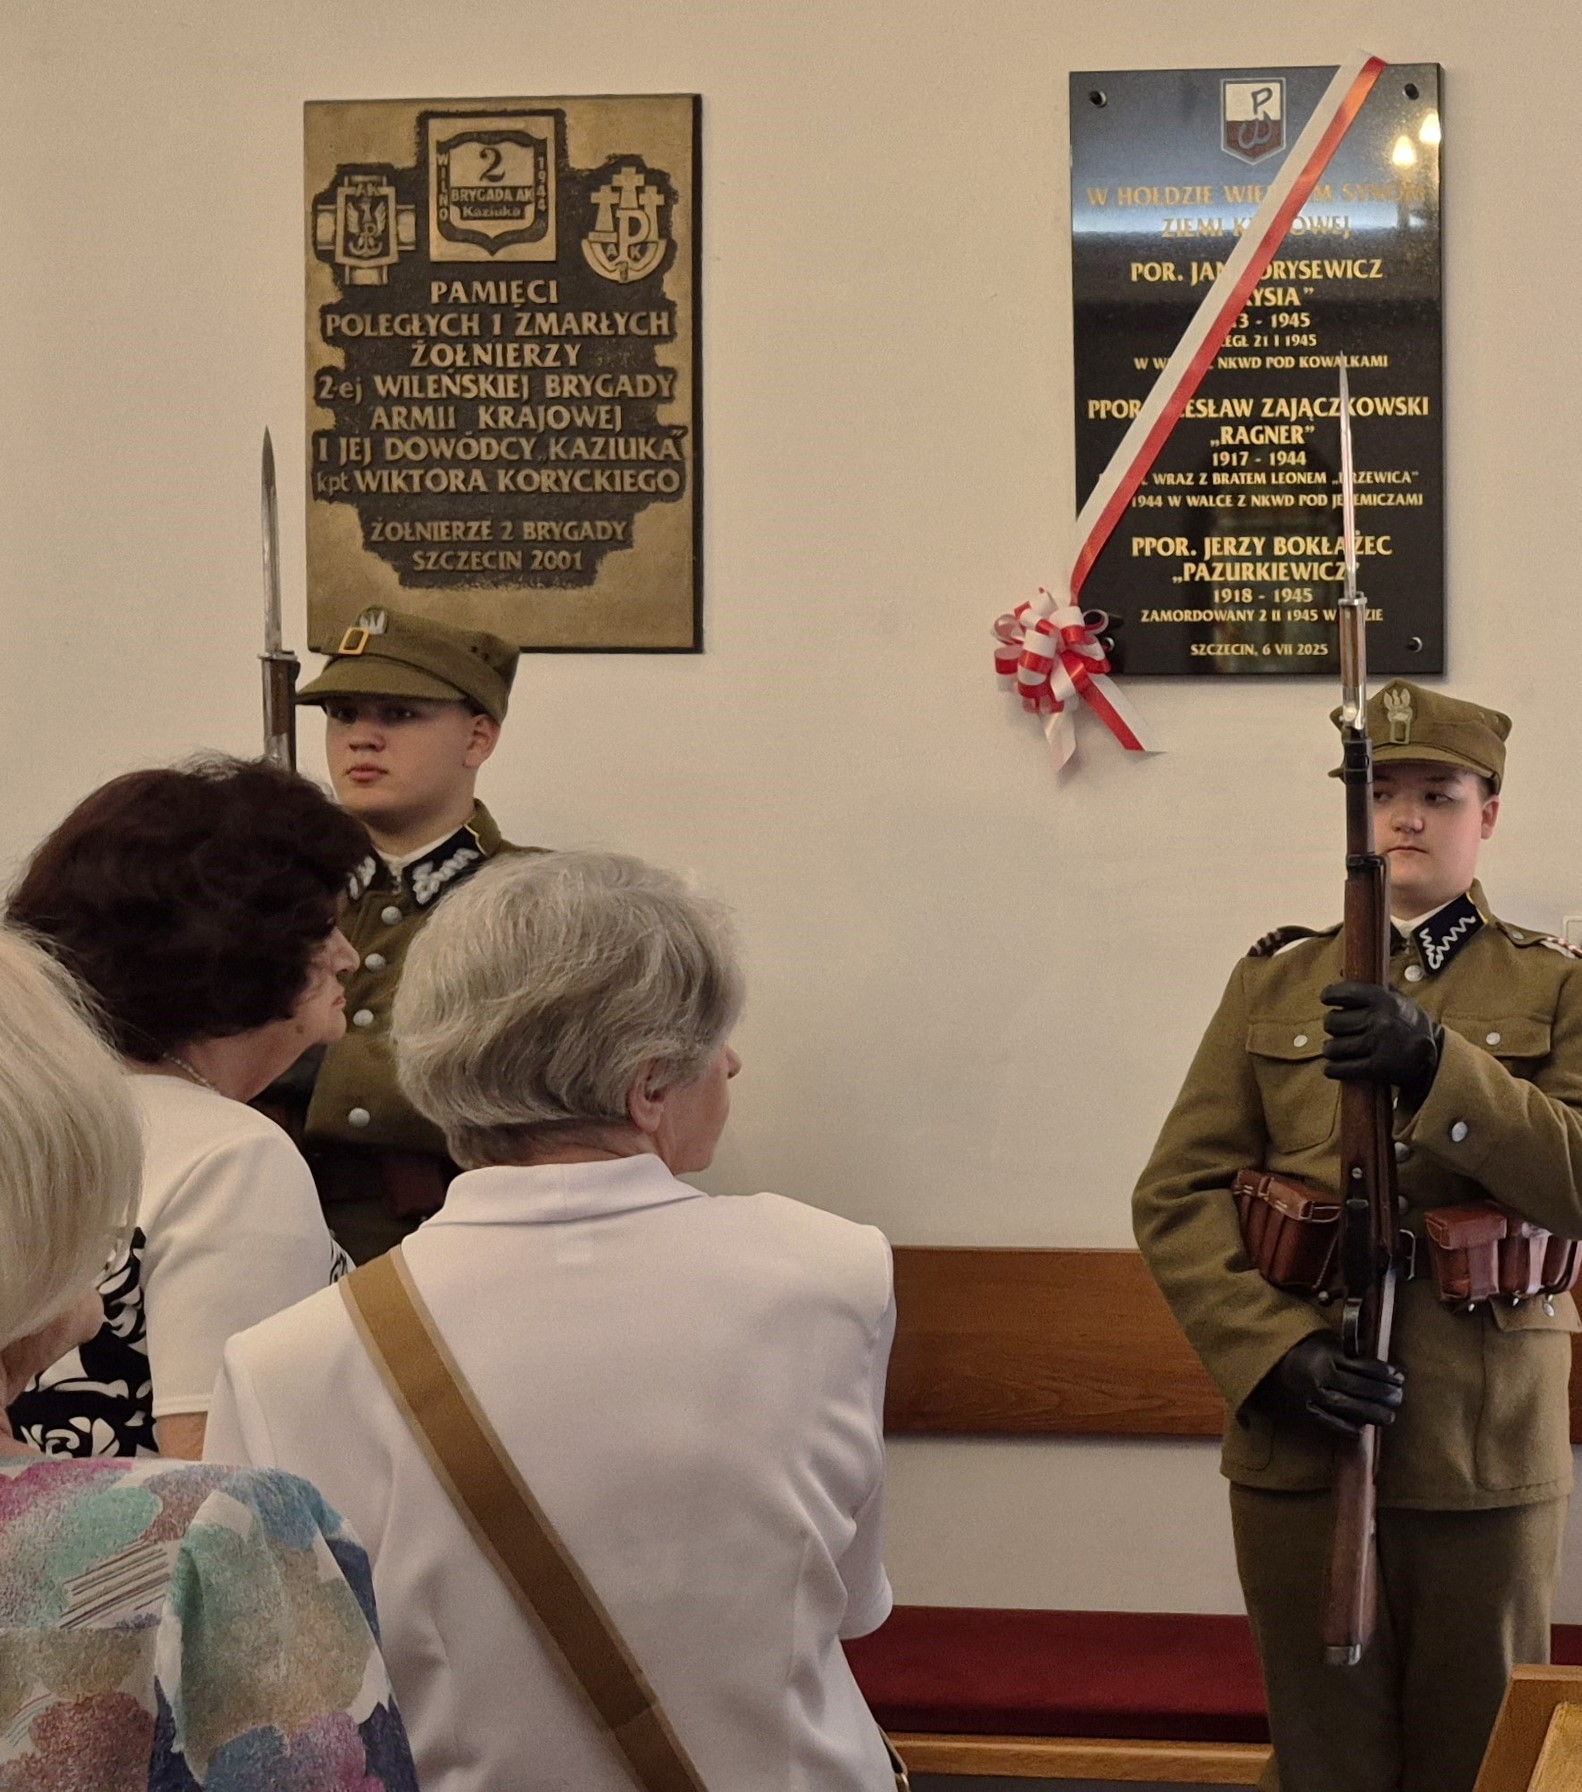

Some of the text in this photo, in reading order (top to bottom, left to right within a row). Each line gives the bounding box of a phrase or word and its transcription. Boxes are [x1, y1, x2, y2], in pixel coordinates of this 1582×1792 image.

[479, 147, 506, 183] 2
[451, 188, 535, 202] BRYGADA AK
[1087, 187, 1109, 206] W
[1161, 217, 1224, 238] ZIEMI
[1130, 261, 1184, 283] POR.
[1190, 260, 1228, 286] JA
[430, 280, 559, 307] PAMIĘCI
[326, 311, 671, 338] POLEGŁYCH I ZMARŁYCH
[1270, 311, 1312, 330] 1945
[1253, 334, 1269, 348] 21
[1285, 333, 1318, 347] 1945
[410, 341, 582, 368] ŻOŁNIERZY
[1133, 357, 1149, 370] W
[1217, 356, 1263, 370] NKWD
[1265, 355, 1296, 369] POD
[373, 368, 529, 404] WILEŃSKIEJ
[545, 373, 676, 399] BRYGADY
[369, 404, 622, 435] ARMII KRAJOWEJ
[1209, 425, 1316, 448] „RAGNER”
[319, 437, 328, 462] I
[339, 437, 372, 467] JEJ
[384, 431, 535, 462] DOWÓDCY
[1211, 451, 1250, 467] 1917
[1268, 450, 1308, 466] 1944
[353, 468, 488, 493] WIKTORA
[499, 468, 681, 493] KORYCKIEGO
[1152, 472, 1195, 486] WRAZ
[1199, 472, 1208, 485] Z
[1211, 471, 1266, 486] BRATEM
[1271, 471, 1327, 485] LEONEM
[1131, 495, 1163, 508] 1944
[1167, 494, 1182, 508] W
[1186, 494, 1234, 508] WALCE
[1236, 494, 1246, 507] Z
[1250, 494, 1295, 507] NKWD
[1298, 493, 1329, 507] POD
[370, 517, 627, 542] ŻOŁNIERZE 2 BRYGADY
[1131, 536, 1197, 557] PPOR.
[1203, 536, 1266, 559] JERZY
[413, 549, 582, 571] SZCZECIN 2001
[1213, 587, 1253, 604] 1918
[1273, 587, 1313, 604] 1945
[1140, 609, 1255, 623] ZAMORDOWANY
[1258, 609, 1268, 622] 2
[1286, 608, 1319, 622] 1945
[1322, 608, 1338, 622] W
[1190, 643, 1329, 657] SZCZECIN, 6 VII 2025
